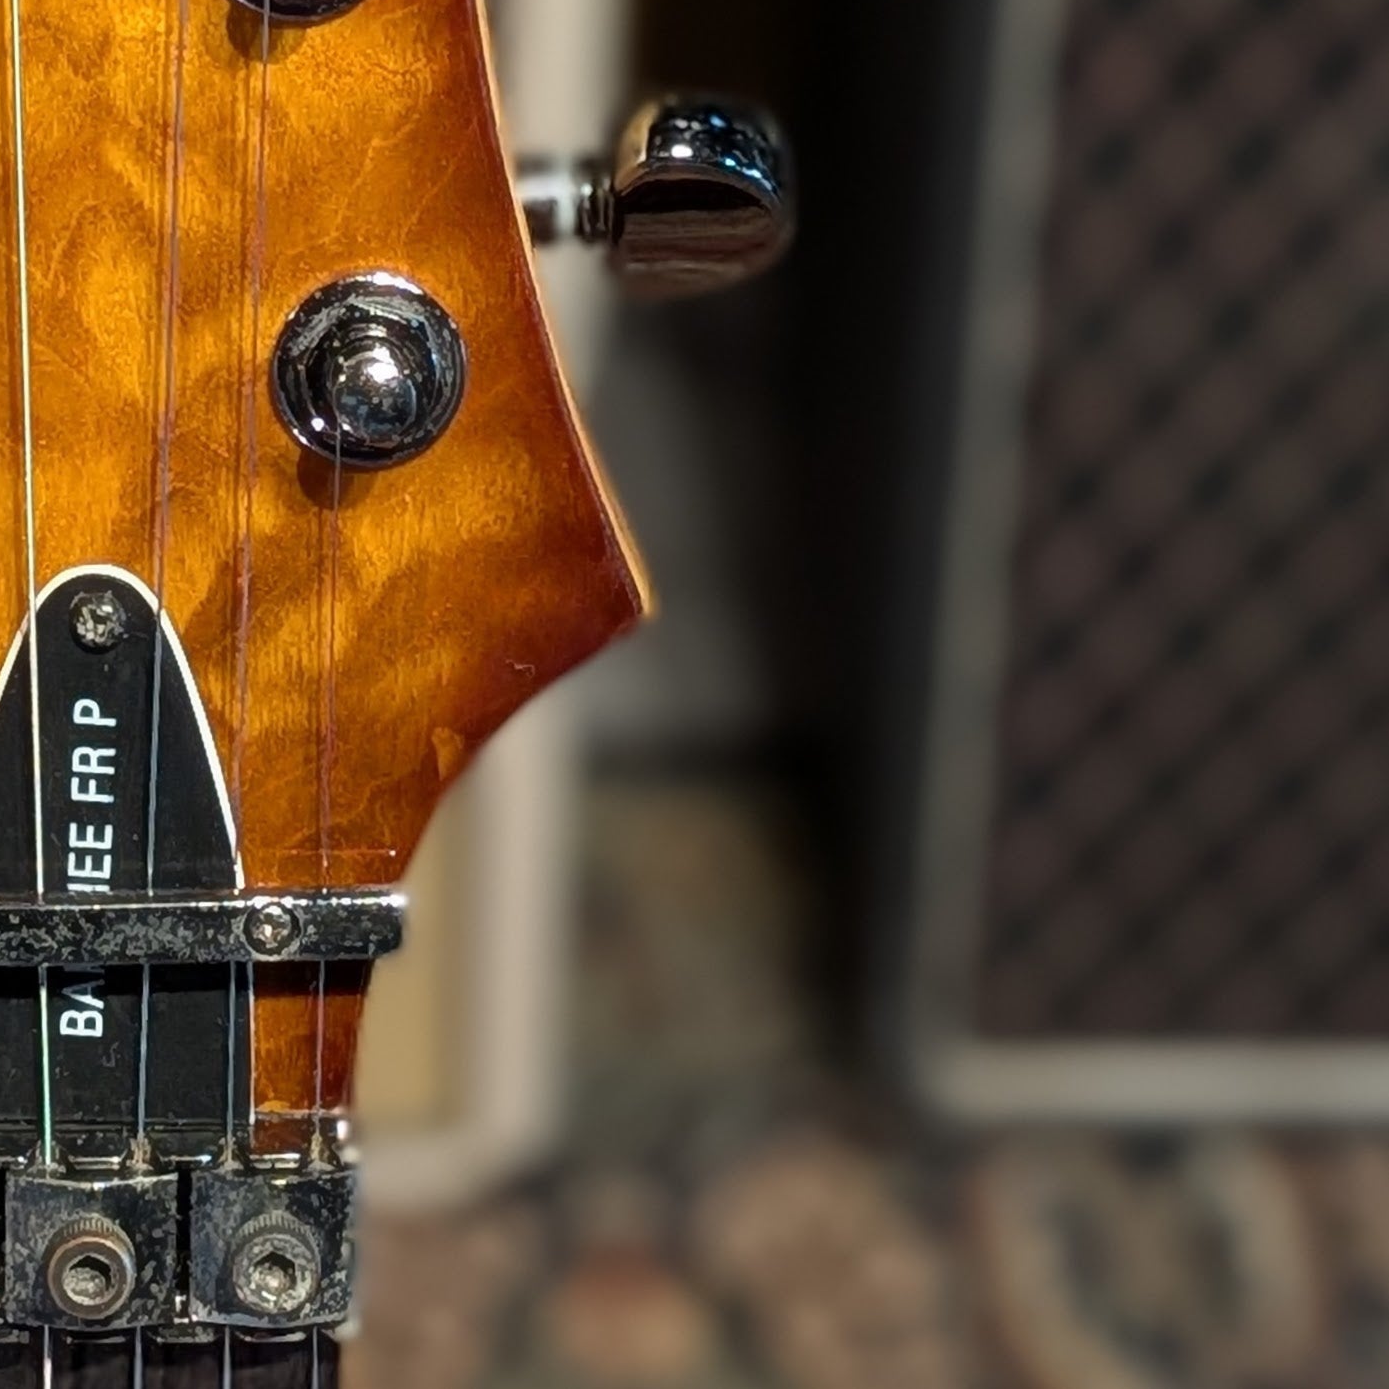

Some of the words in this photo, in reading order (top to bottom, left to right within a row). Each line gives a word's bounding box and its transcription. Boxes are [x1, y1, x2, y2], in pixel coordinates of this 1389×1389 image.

[73, 698, 117, 727] P
[70, 746, 116, 803] FR
[59, 820, 114, 1038] BAEE
